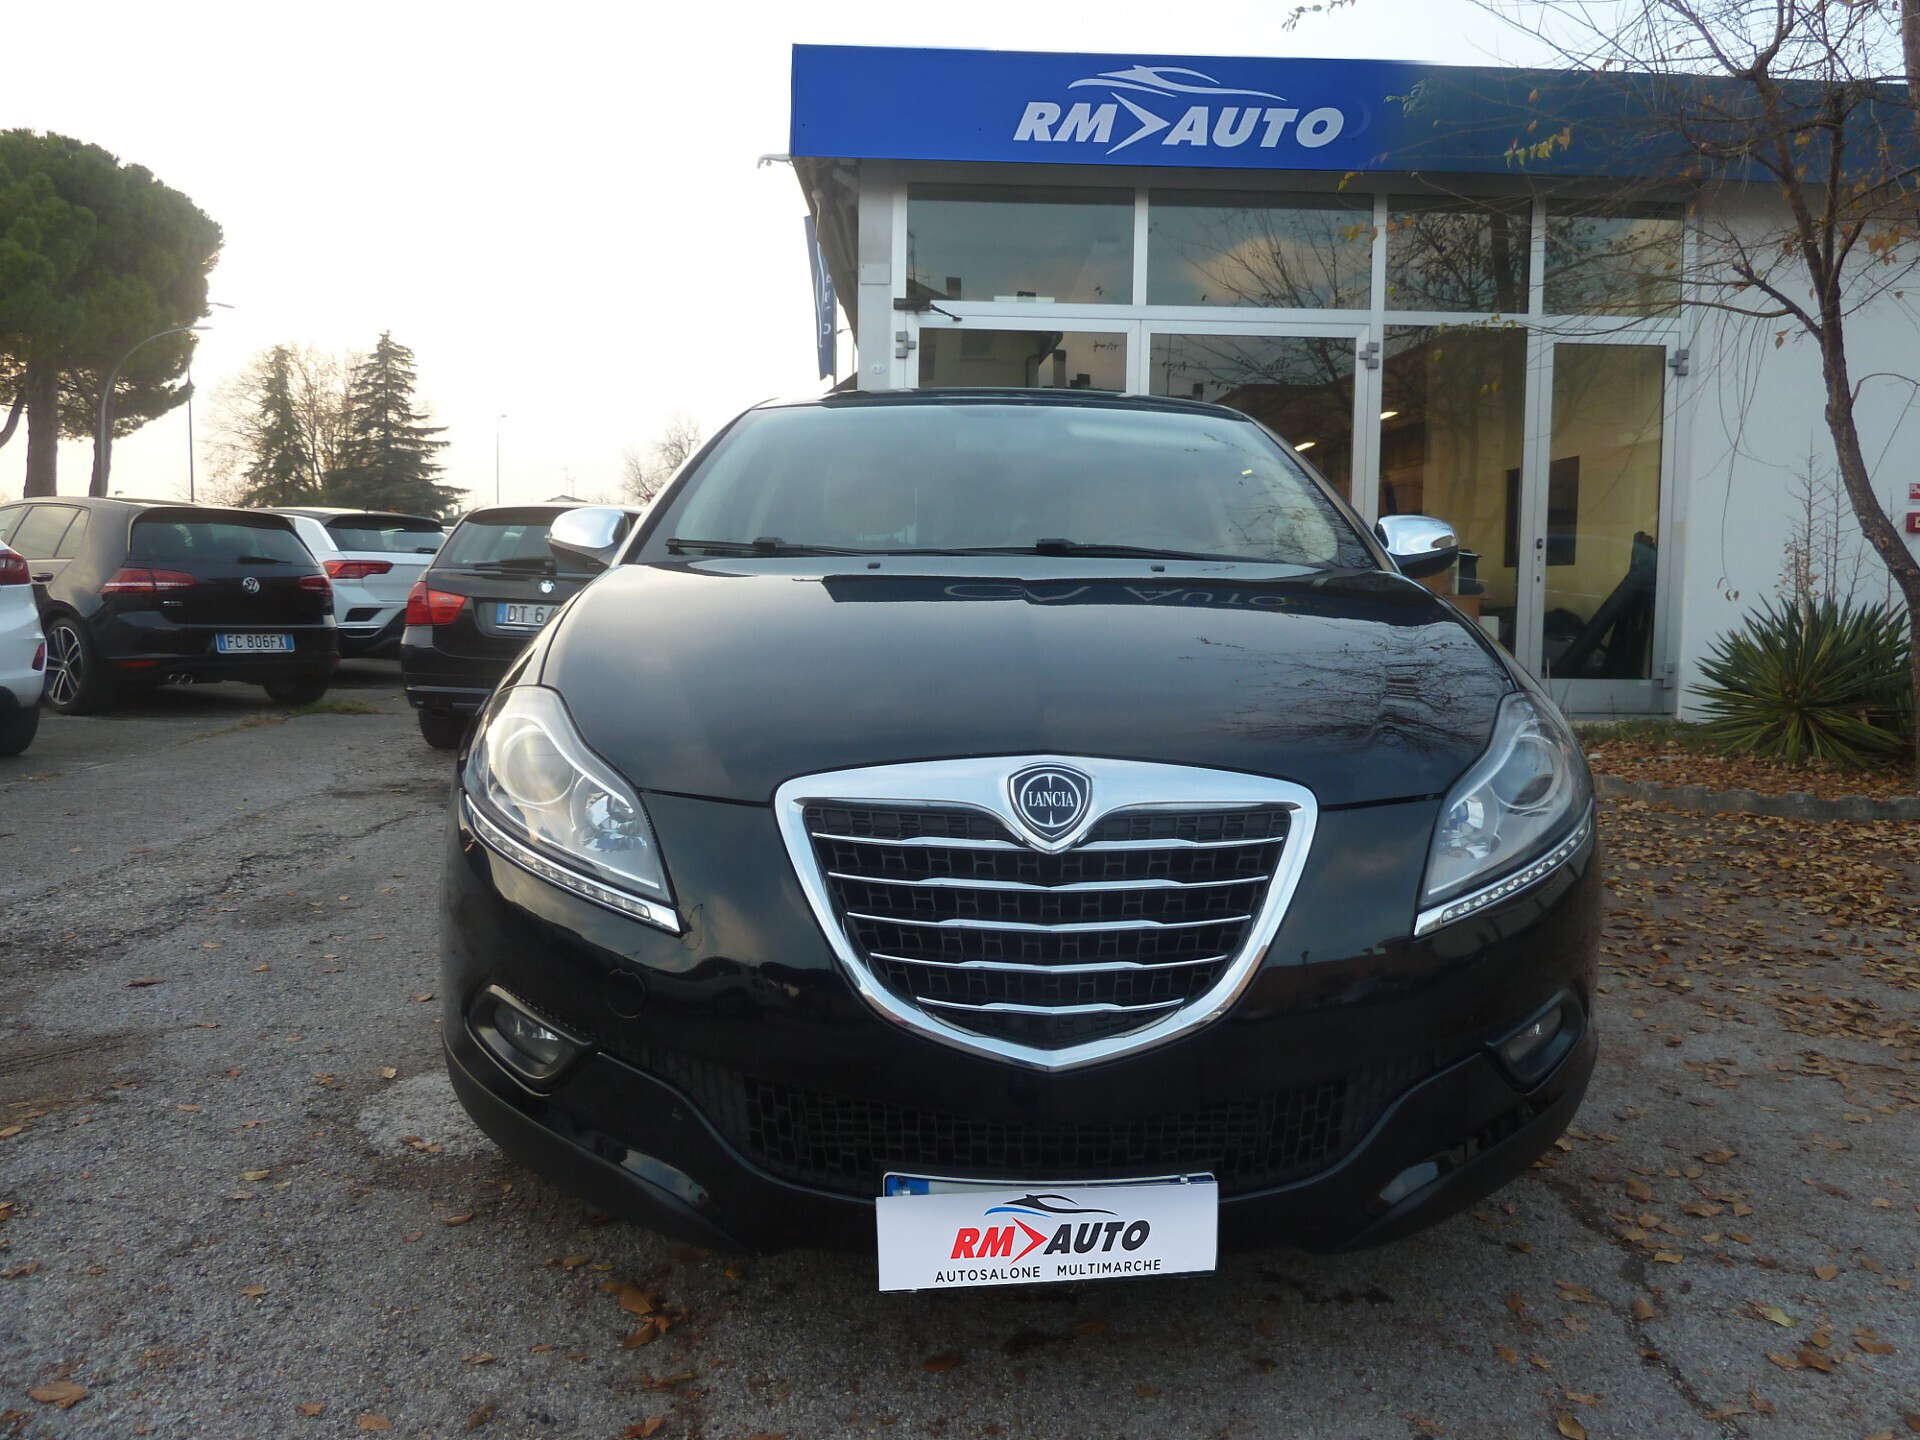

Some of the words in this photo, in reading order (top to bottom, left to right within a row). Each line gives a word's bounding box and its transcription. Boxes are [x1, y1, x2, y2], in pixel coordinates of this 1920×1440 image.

[1012, 101, 1118, 143] RM
[1161, 106, 1345, 148] AUTO
[507, 605, 529, 622] DT
[1027, 790, 1075, 807] LANCIA
[950, 1226, 1016, 1260] RM
[1043, 1219, 1151, 1255] AUTO
[935, 1265, 1041, 1283] AUTOSALONE
[1057, 1258, 1162, 1277] MULTIMARCHE
